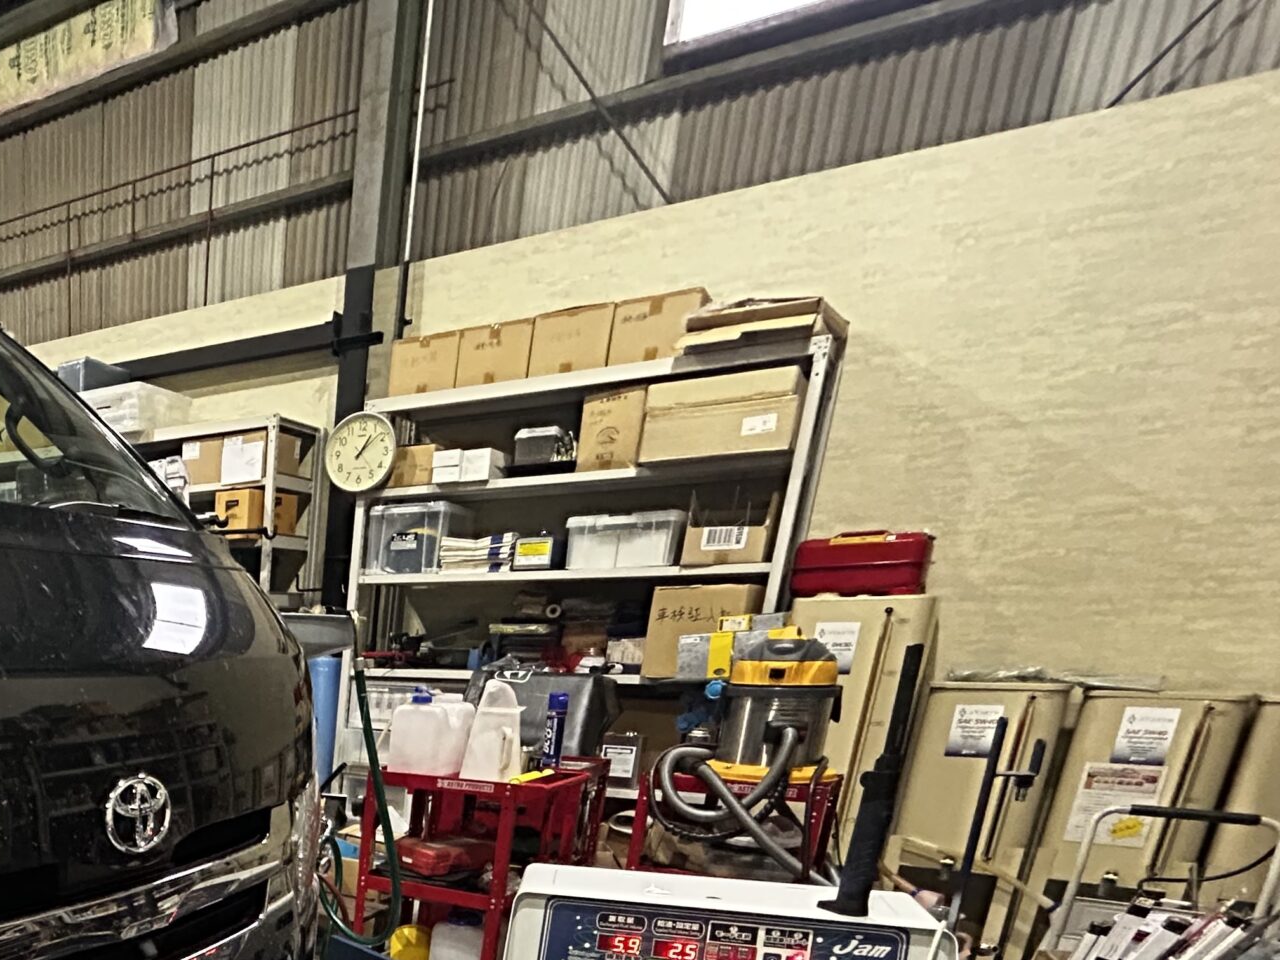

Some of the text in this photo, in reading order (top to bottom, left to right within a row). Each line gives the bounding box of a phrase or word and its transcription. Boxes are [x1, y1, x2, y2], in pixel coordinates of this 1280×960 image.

[359, 420, 368, 431] 12
[347, 426, 355, 436] 11
[339, 436, 348, 447] 10
[335, 450, 342, 460] 9
[382, 446, 389, 456] 3
[337, 463, 344, 473] 8
[377, 460, 384, 469] 4
[346, 471, 352, 481] 7
[368, 469, 375, 479] 5
[355, 474, 362, 485] 6
